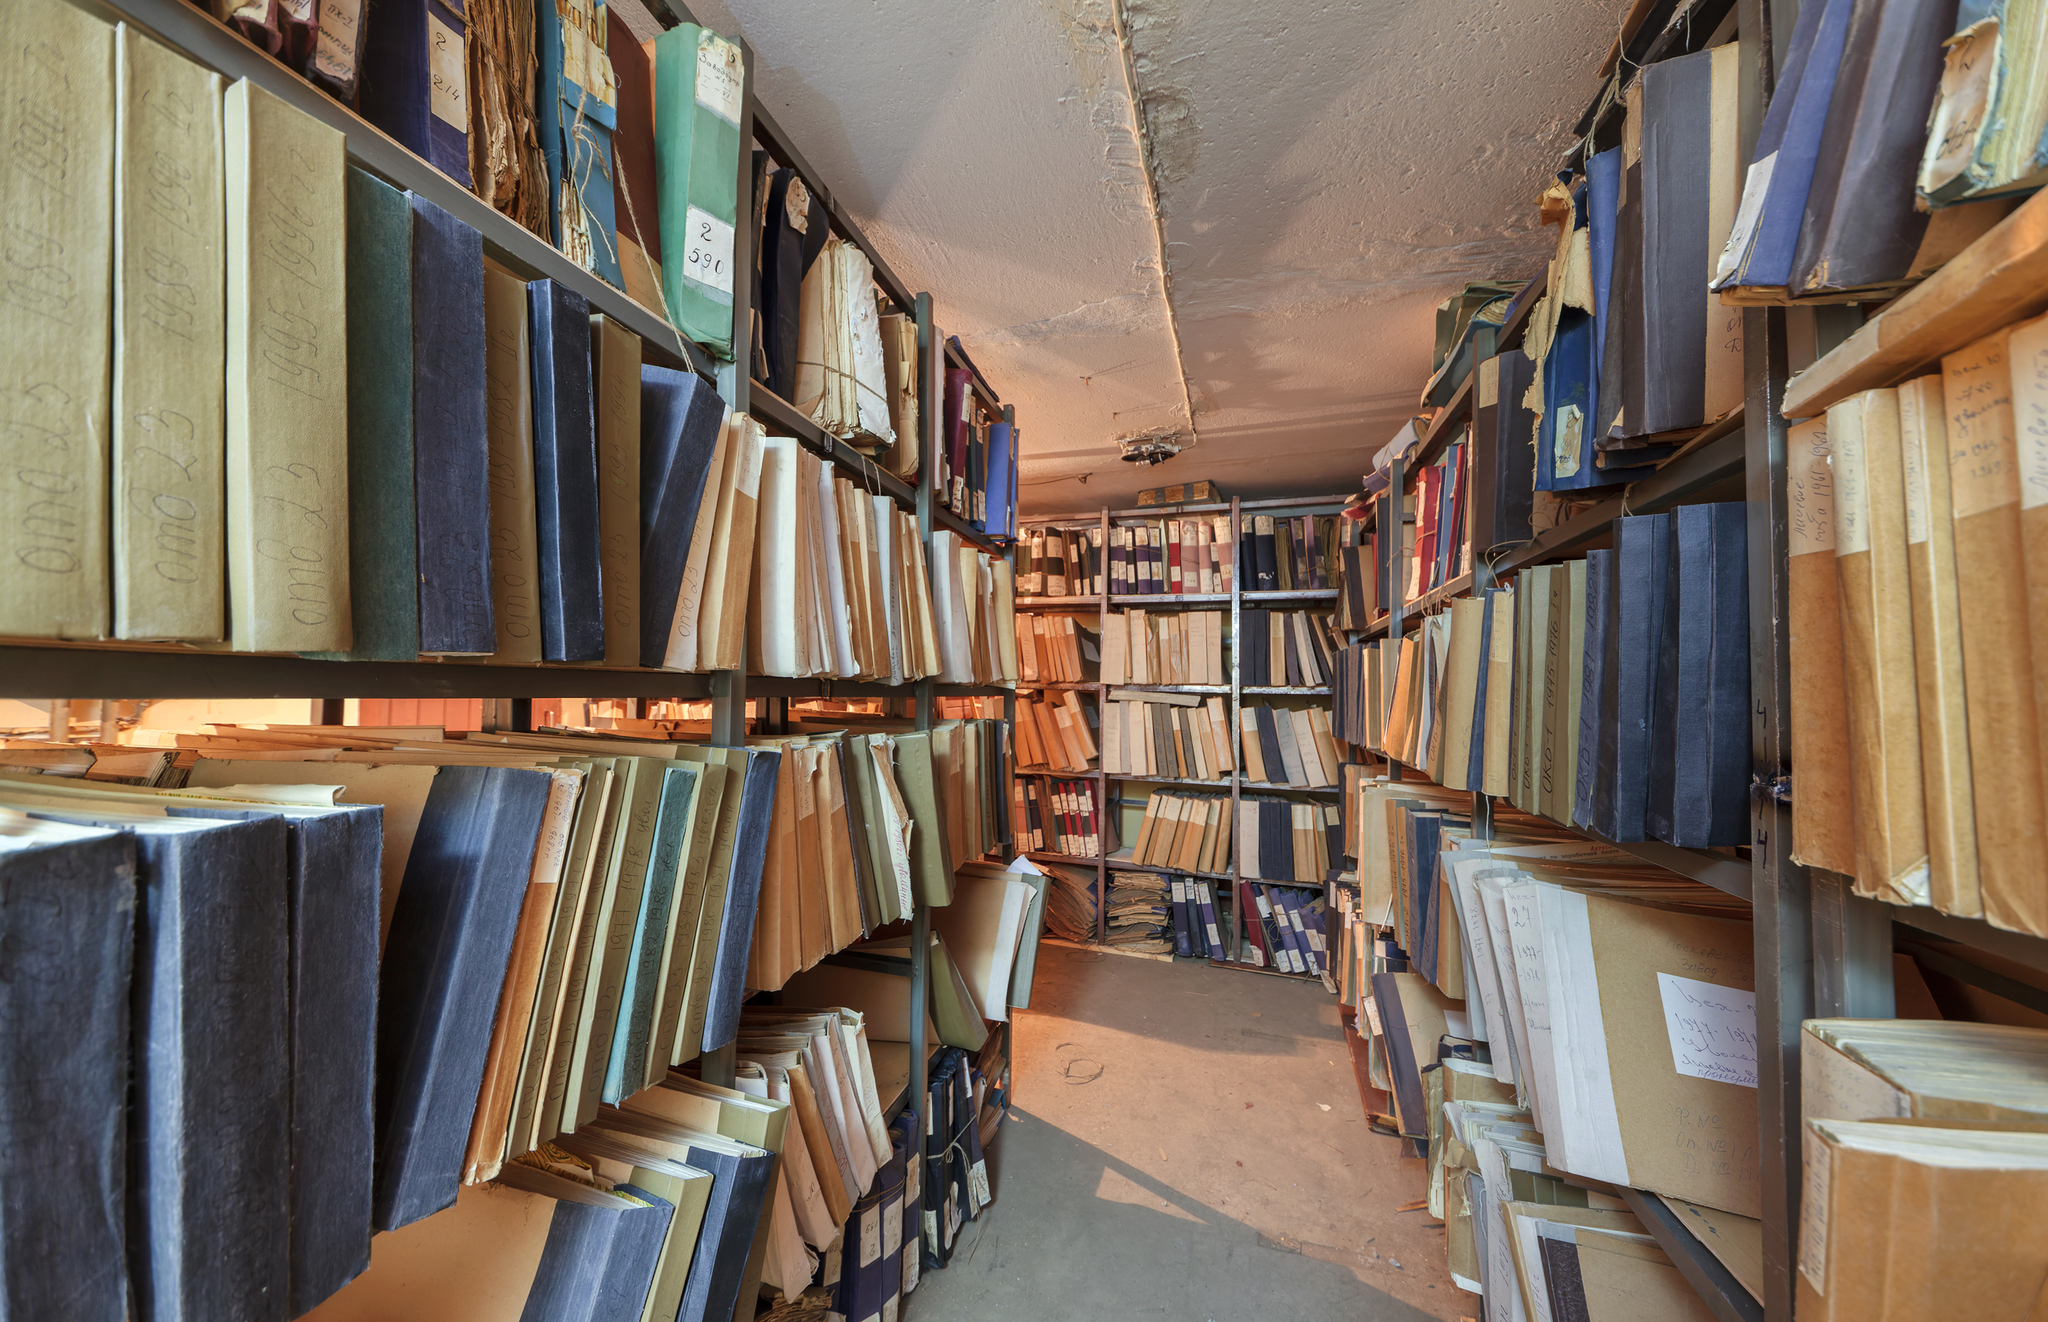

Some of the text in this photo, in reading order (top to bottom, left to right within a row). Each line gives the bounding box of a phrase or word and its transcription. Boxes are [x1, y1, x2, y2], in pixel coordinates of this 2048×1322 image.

[435, 32, 448, 52] 2
[433, 73, 460, 101] 214
[700, 222, 712, 242] 2
[688, 248, 724, 275] 590
[869, 1243, 876, 1257] 2
